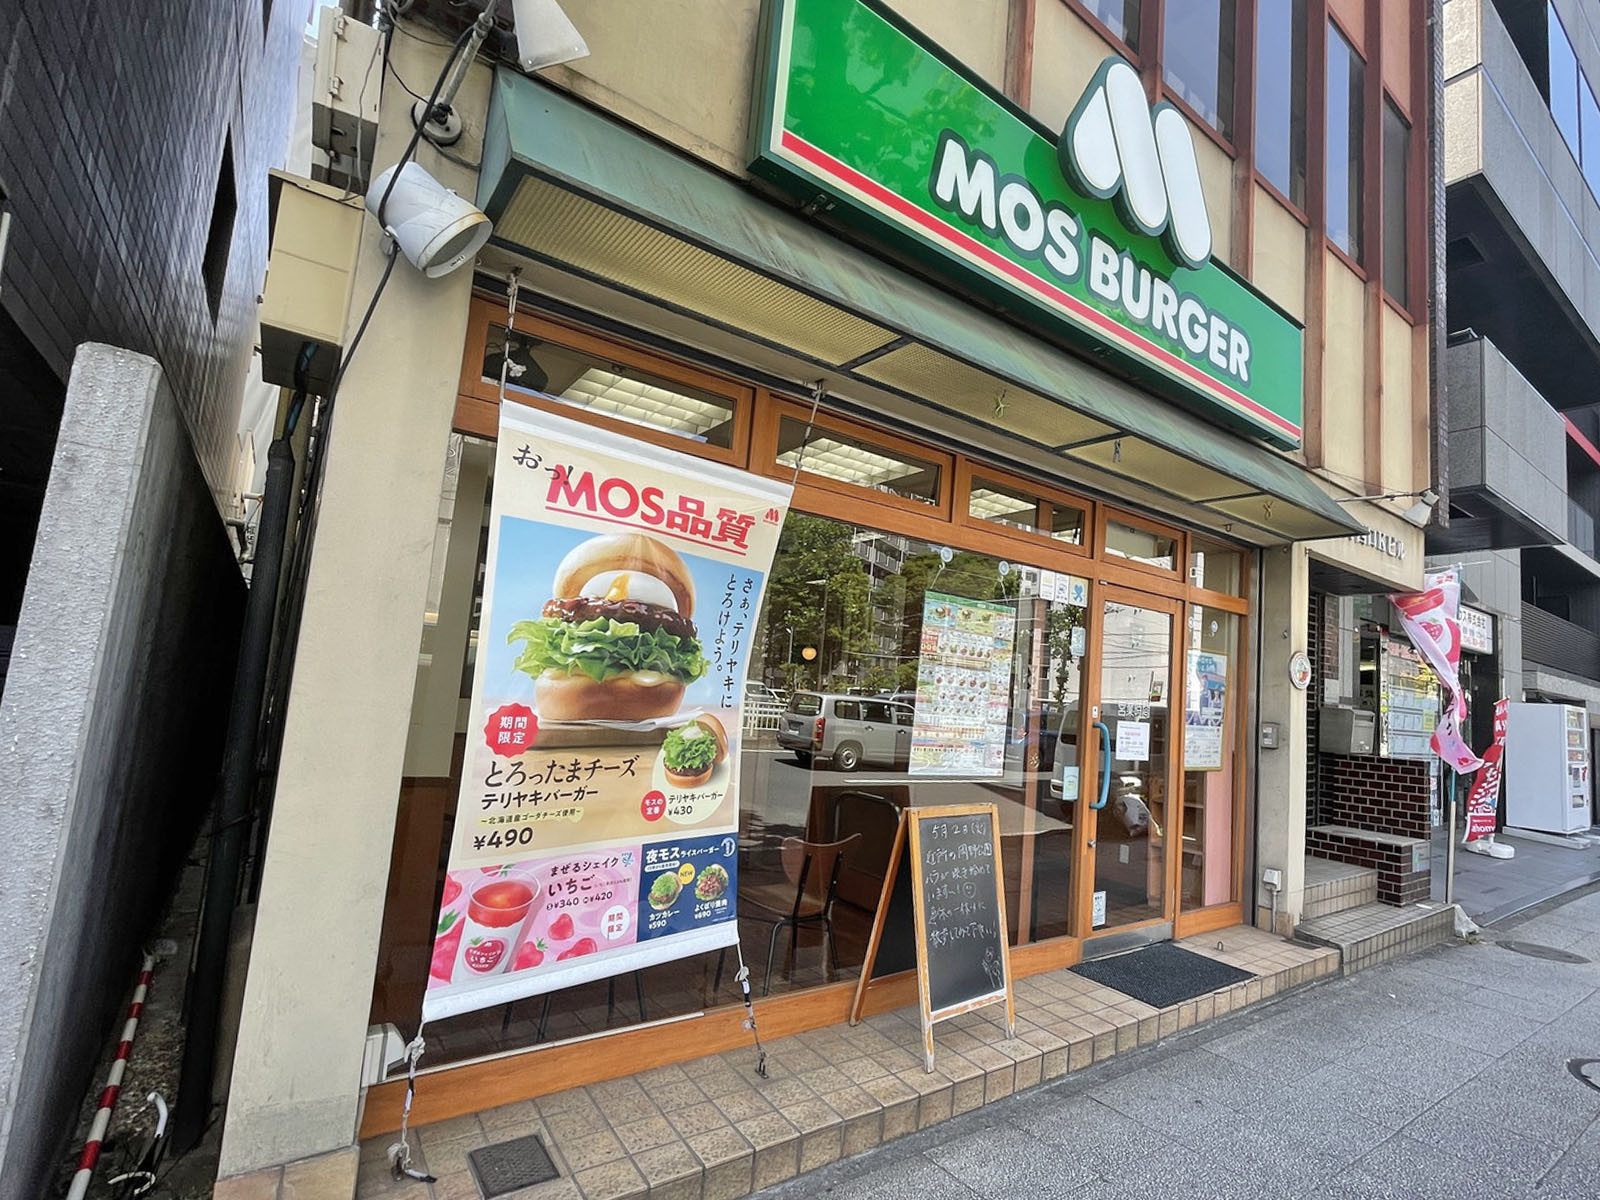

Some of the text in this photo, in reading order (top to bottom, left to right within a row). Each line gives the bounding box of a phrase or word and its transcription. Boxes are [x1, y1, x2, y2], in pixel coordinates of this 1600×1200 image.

[934, 137, 1250, 383] MOS BURGER
[545, 464, 756, 549] MOS品質
[714, 573, 737, 672] とろけよう。
[499, 716, 528, 730] 期間
[497, 732, 526, 745] 限定
[484, 754, 641, 788] とろったまチーズ
[481, 785, 599, 810] テリヤキバーガー
[668, 791, 724, 805] テリヤキバーガー
[668, 805, 693, 816] ¥430
[473, 826, 534, 850] ¥490
[646, 847, 680, 864] 夜モス
[550, 857, 619, 877] まぜるシェイク
[679, 870, 693, 879] NEW
[548, 874, 596, 897] いちご
[648, 909, 681, 922] カツカレー
[648, 920, 668, 930] ¥590
